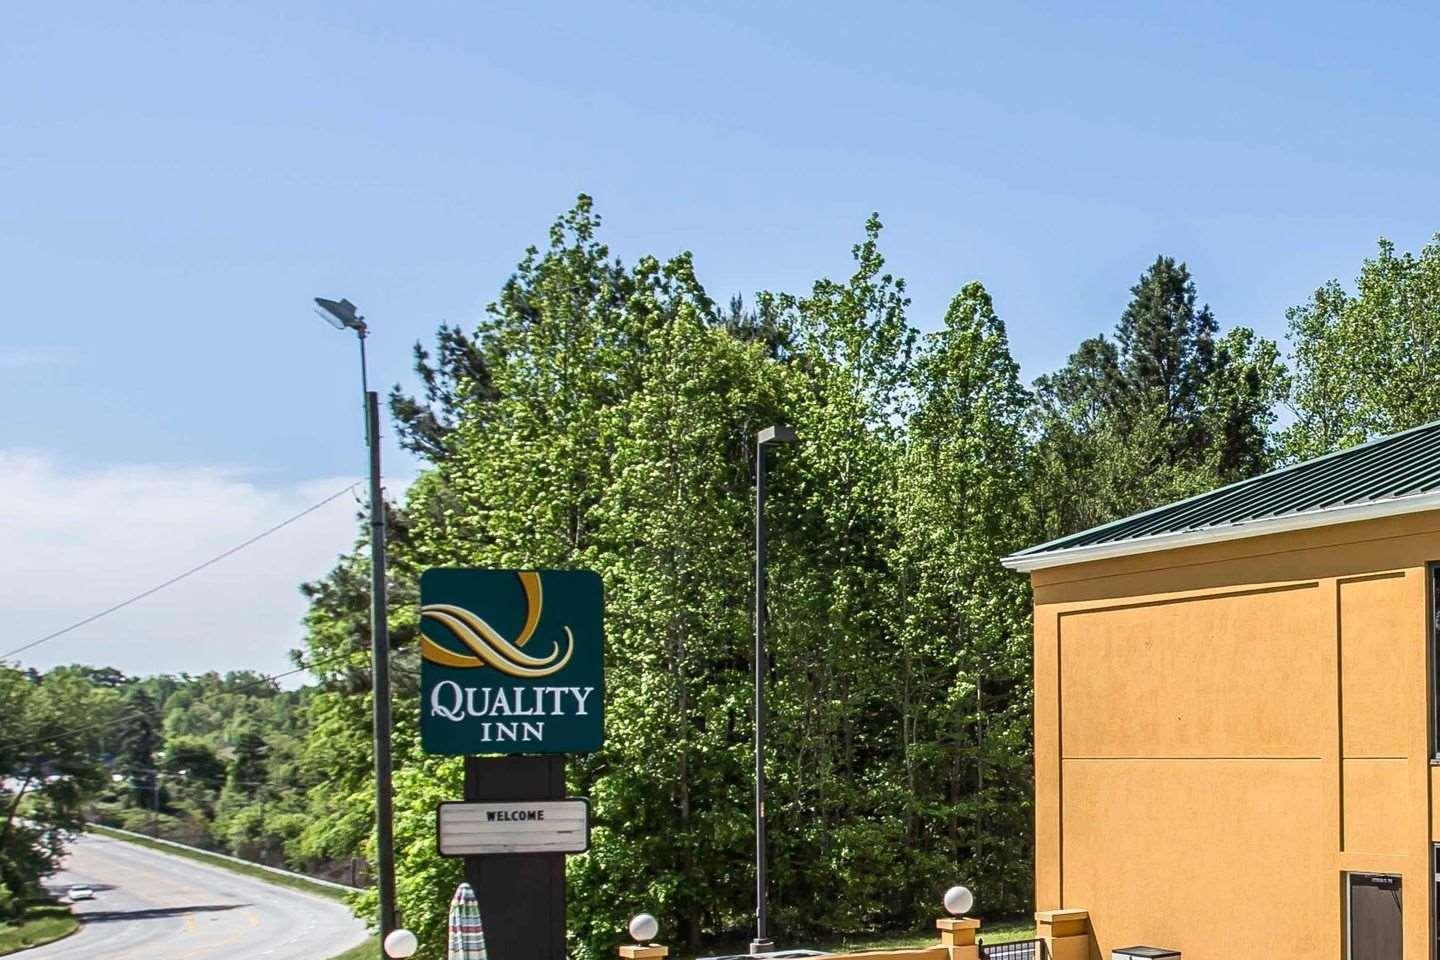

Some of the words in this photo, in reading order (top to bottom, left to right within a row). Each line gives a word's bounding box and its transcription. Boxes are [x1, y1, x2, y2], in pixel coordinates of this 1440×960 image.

[431, 680, 594, 722] QUALITY
[481, 722, 544, 741] INN
[487, 810, 544, 821] WELCOME
